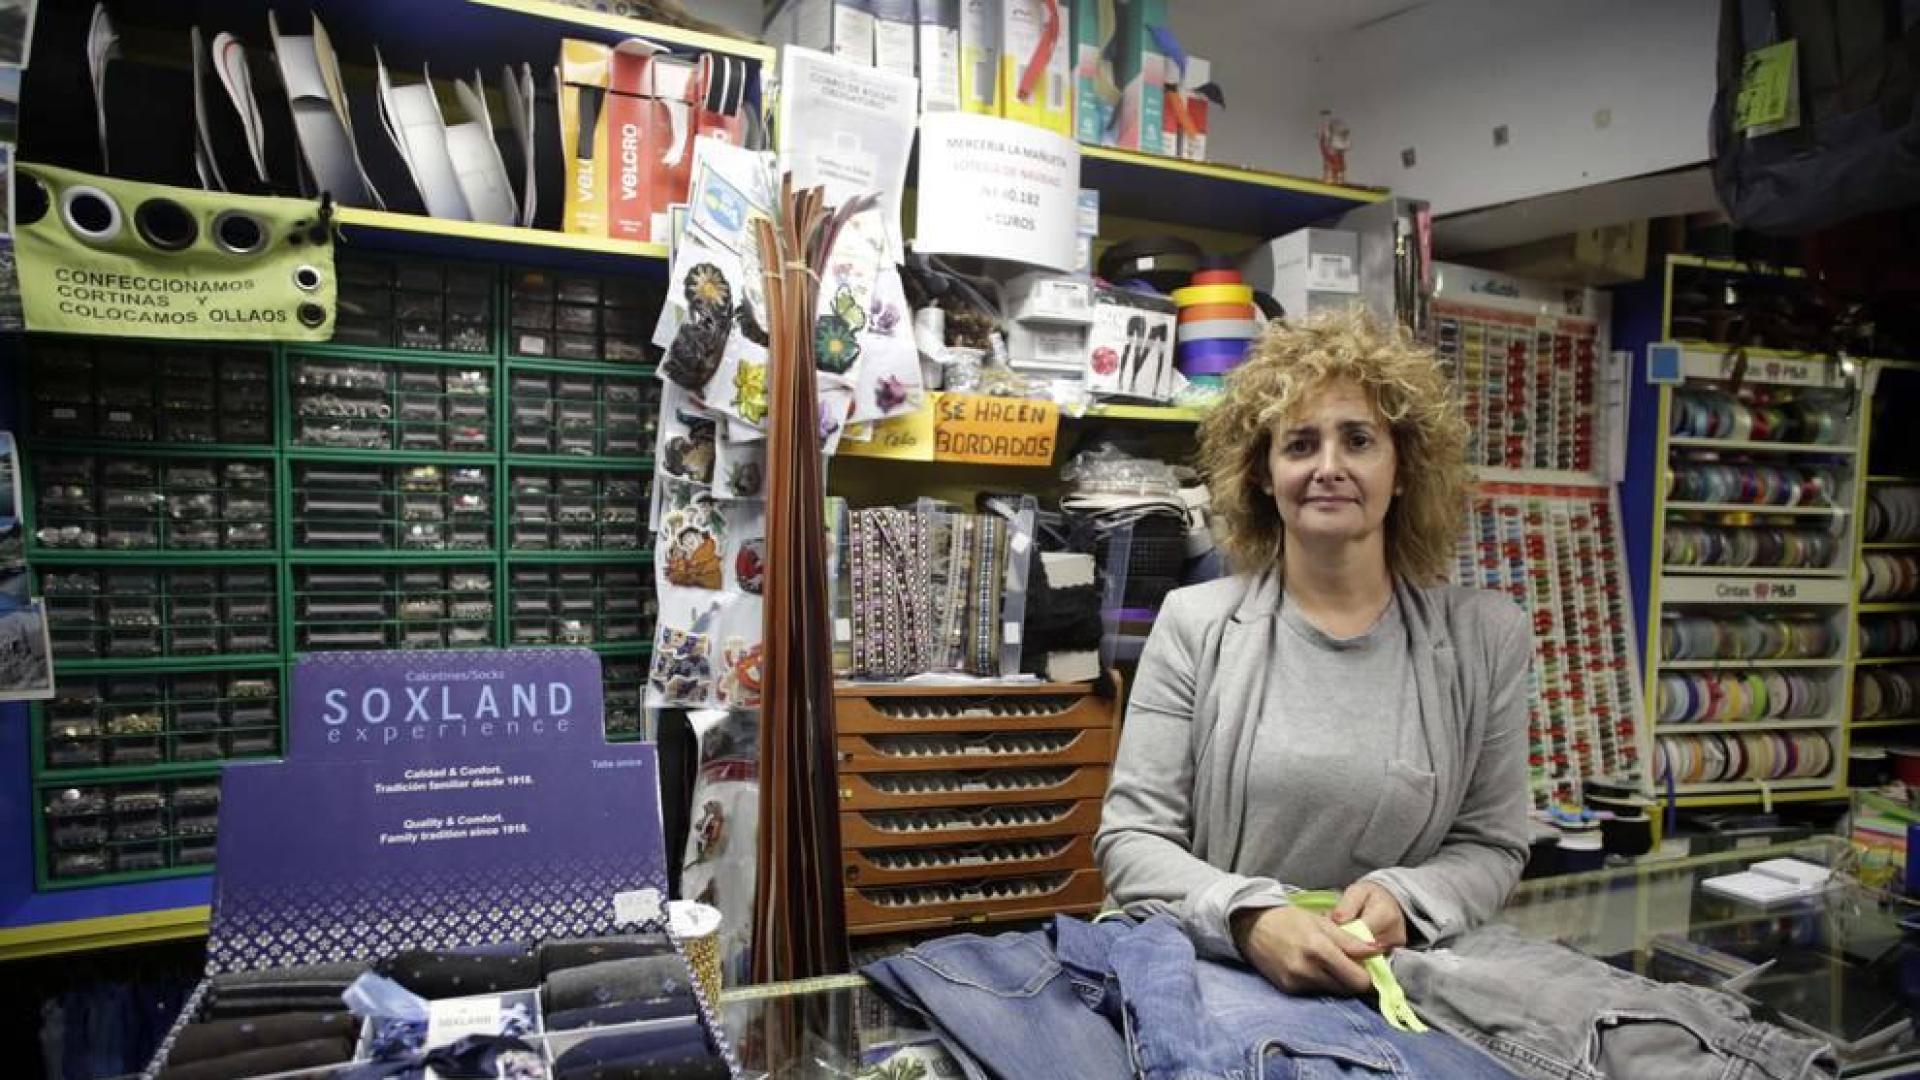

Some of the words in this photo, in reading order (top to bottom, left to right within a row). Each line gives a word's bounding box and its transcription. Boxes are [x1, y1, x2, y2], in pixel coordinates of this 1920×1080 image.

[1008, 144, 1020, 155] LA
[55, 268, 255, 293] CONFECCIONAMOS
[57, 284, 170, 308] CORTINAS
[196, 295, 209, 306] Y
[59, 301, 199, 325] COLOCAMOS
[208, 309, 288, 323] OLLAOS
[940, 400, 965, 421] SE
[975, 401, 1046, 423] HACEN
[935, 429, 1051, 457] BORDADOS
[322, 682, 573, 725] SOXLAND
[327, 717, 570, 745] experience
[374, 781, 428, 794] Tradición
[429, 778, 471, 791] familiar
[472, 776, 505, 788] desde
[404, 768, 447, 780] Calidad
[449, 767, 458, 777] &
[403, 818, 443, 830] Quality
[446, 816, 455, 826] &
[380, 832, 418, 846] Family
[420, 828, 468, 842] tradition
[469, 825, 500, 838] since
